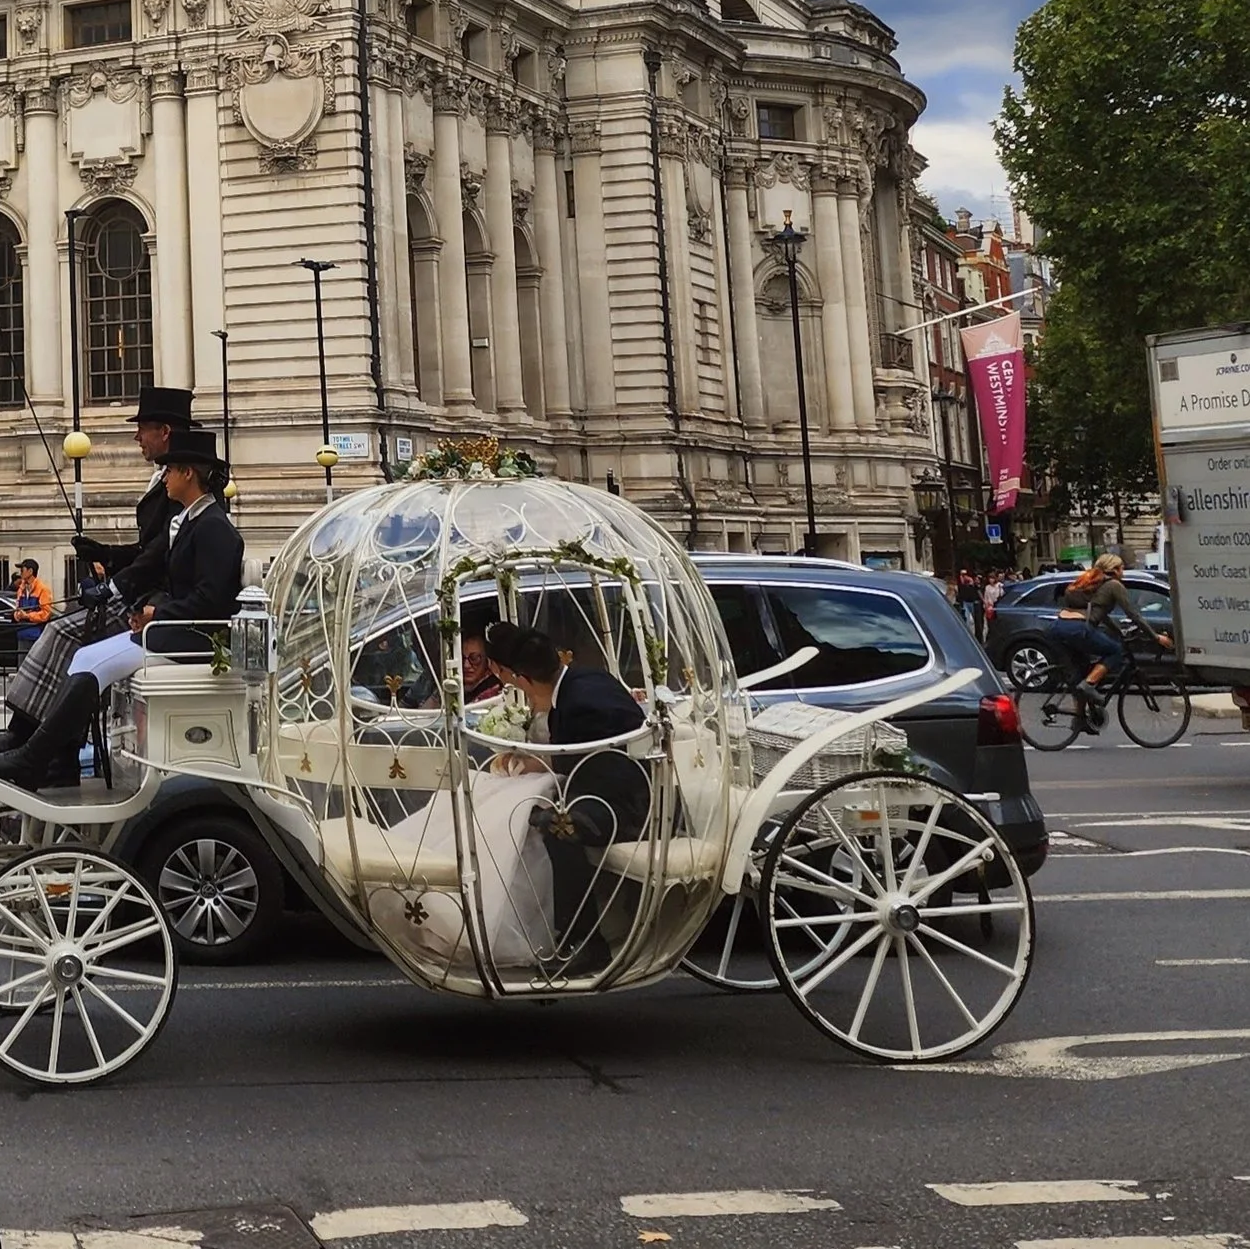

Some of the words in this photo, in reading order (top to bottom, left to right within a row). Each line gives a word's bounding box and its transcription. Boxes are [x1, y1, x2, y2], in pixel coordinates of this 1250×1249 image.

[1180, 395, 1189, 412] A
[1191, 391, 1238, 411] Promise
[1207, 456, 1231, 471] Order
[1178, 485, 1250, 511] allenshir
[1198, 533, 1231, 546] London
[1193, 563, 1219, 578] South
[1221, 564, 1247, 579] Coast
[1197, 595, 1225, 610] South
[1226, 596, 1250, 611] West
